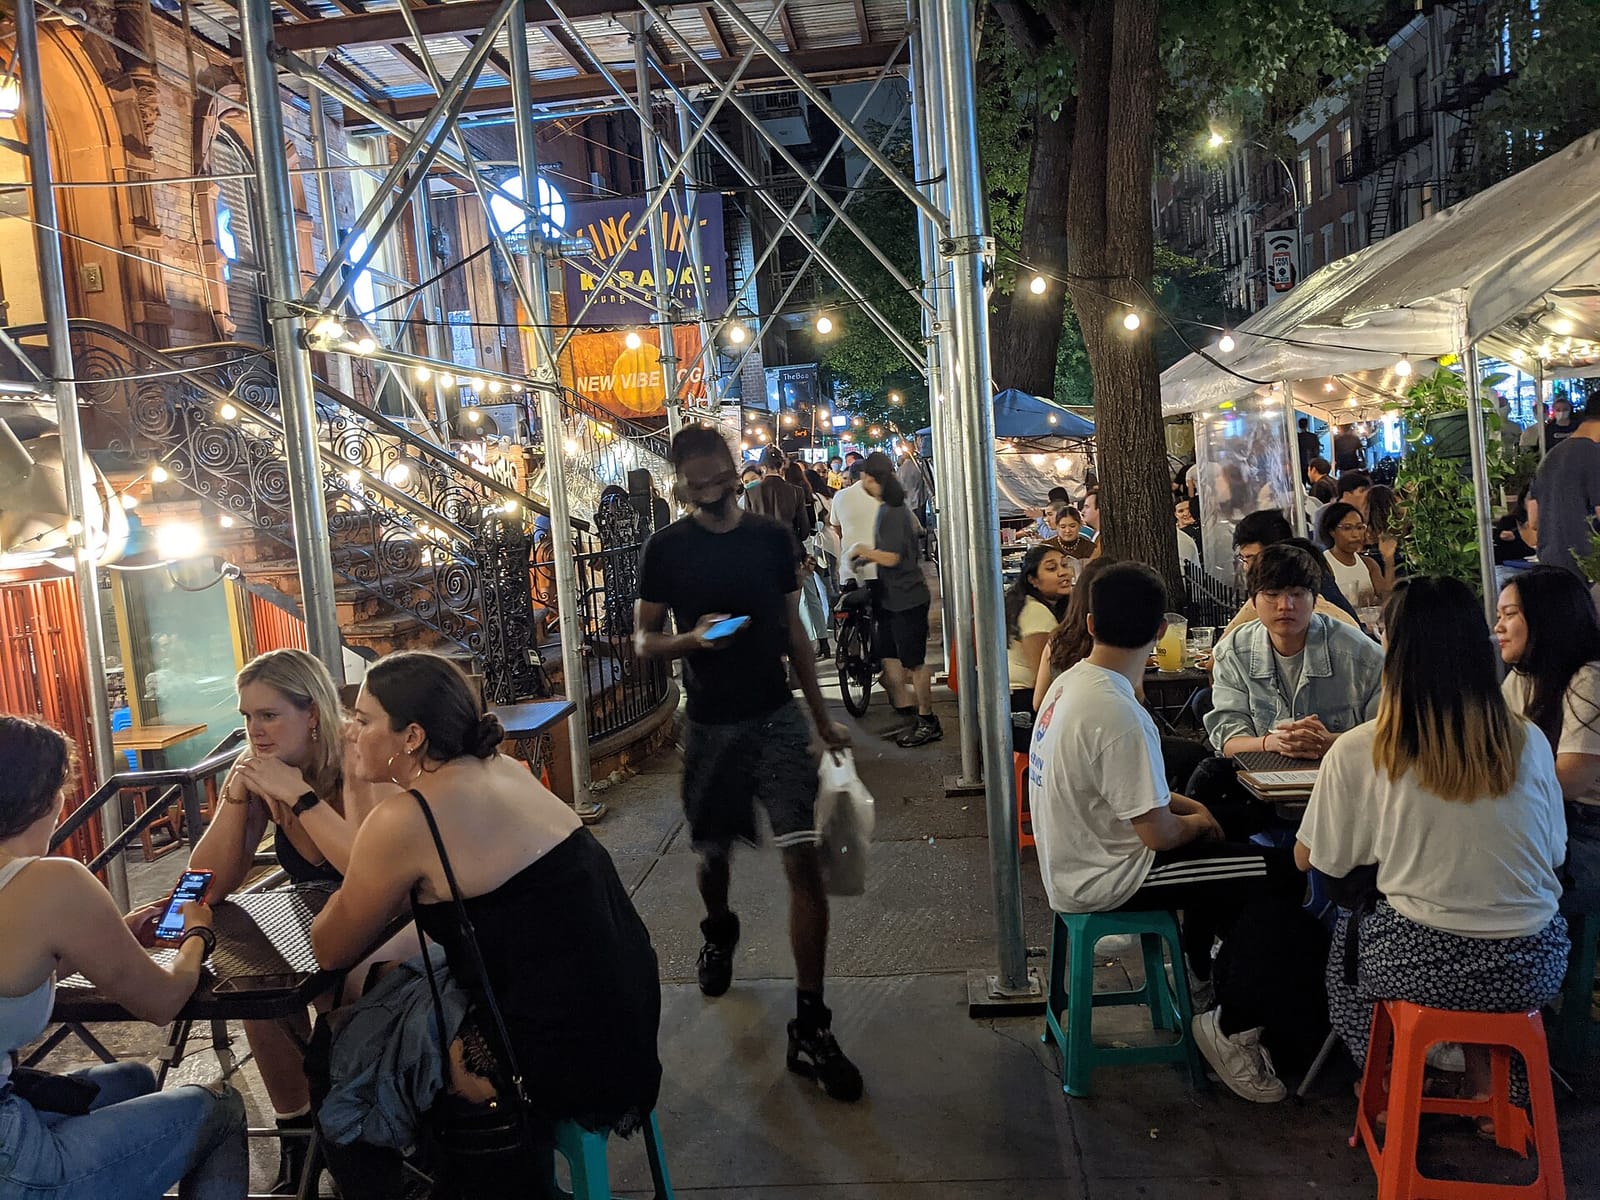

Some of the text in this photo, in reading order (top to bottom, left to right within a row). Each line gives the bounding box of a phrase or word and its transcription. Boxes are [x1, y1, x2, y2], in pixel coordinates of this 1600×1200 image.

[576, 211, 638, 265] ING
[584, 294, 633, 305] lung
[577, 376, 615, 393] NEW
[621, 371, 660, 389] VIBE
